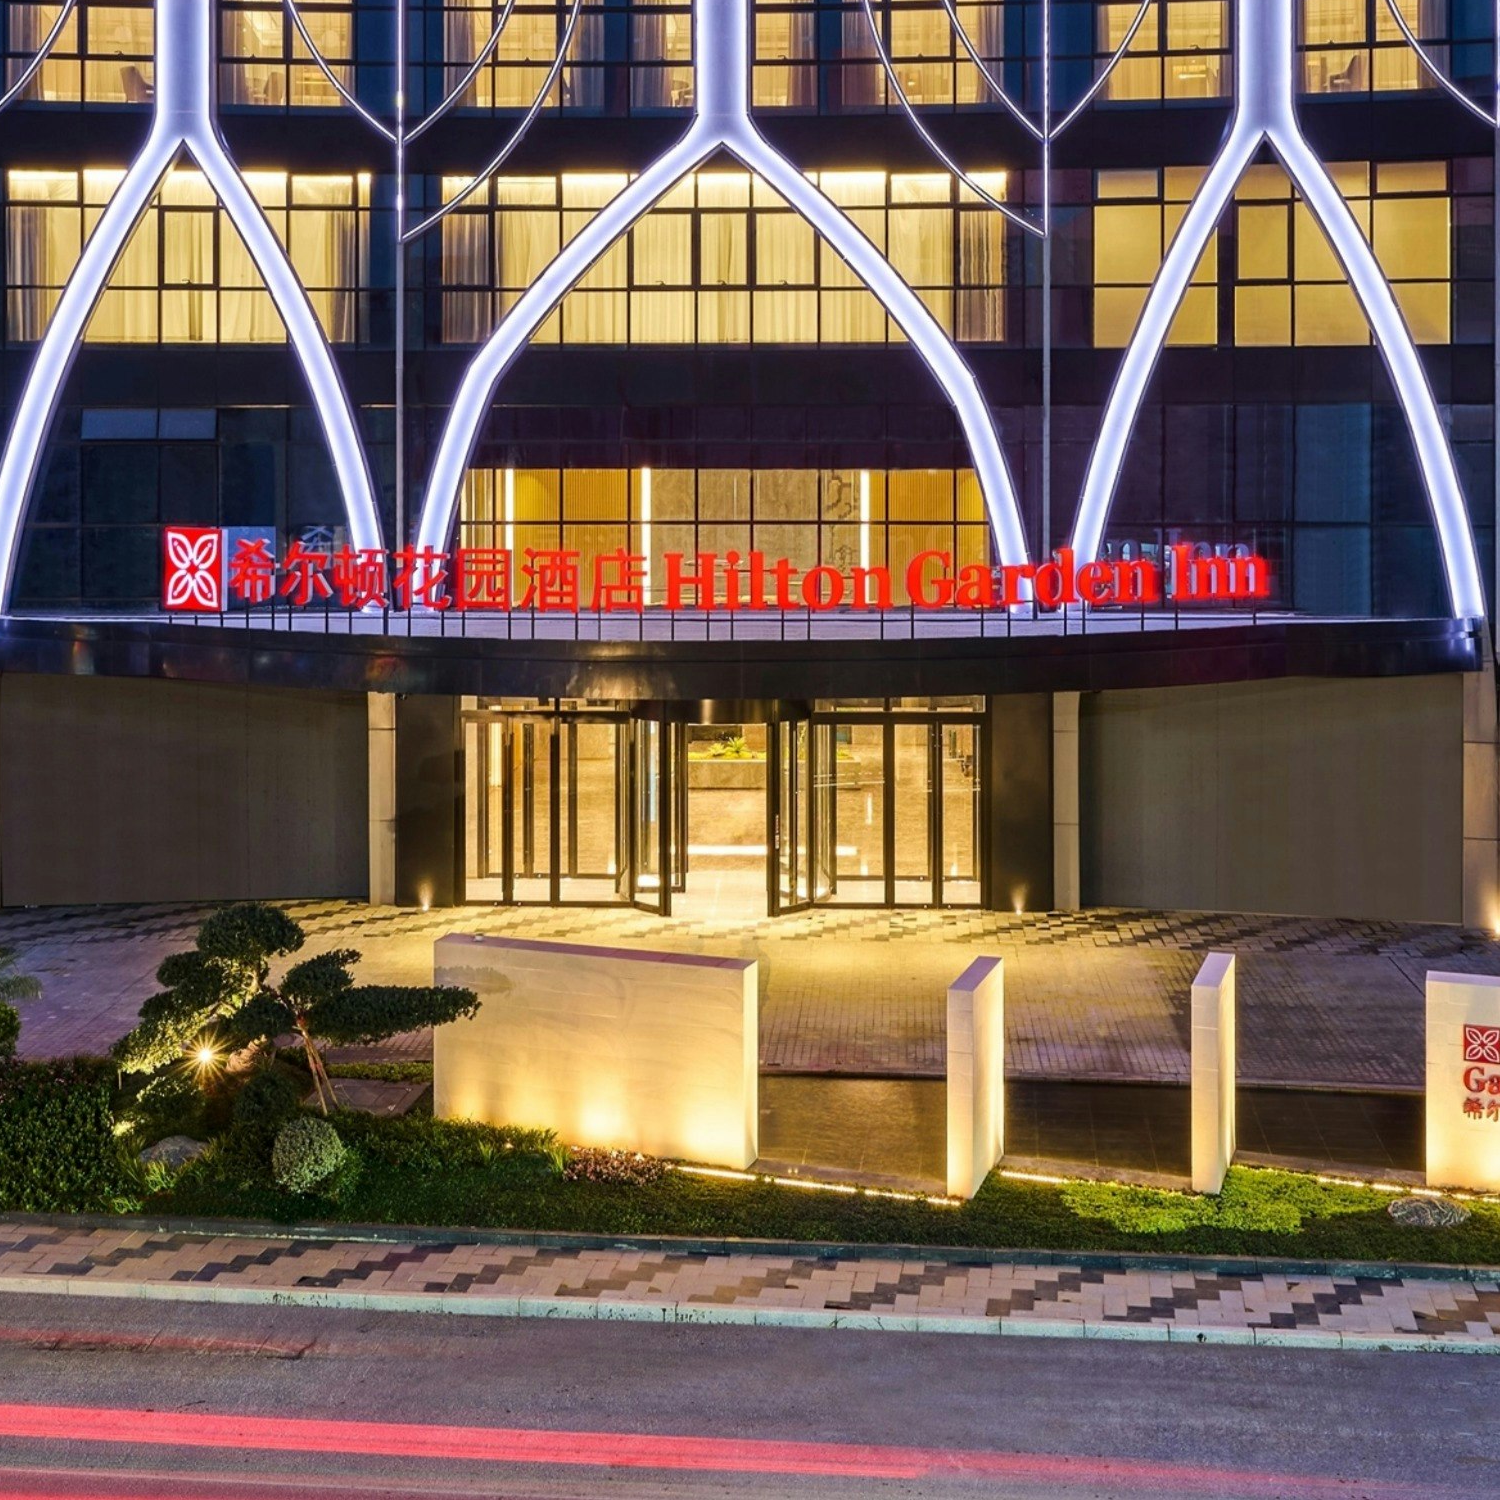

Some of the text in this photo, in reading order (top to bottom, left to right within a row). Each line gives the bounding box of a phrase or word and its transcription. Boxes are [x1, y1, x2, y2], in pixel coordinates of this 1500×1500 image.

[228, 538, 647, 614] 希尔顿花园酒店
[663, 543, 1270, 612] Hilton Garden Inn
